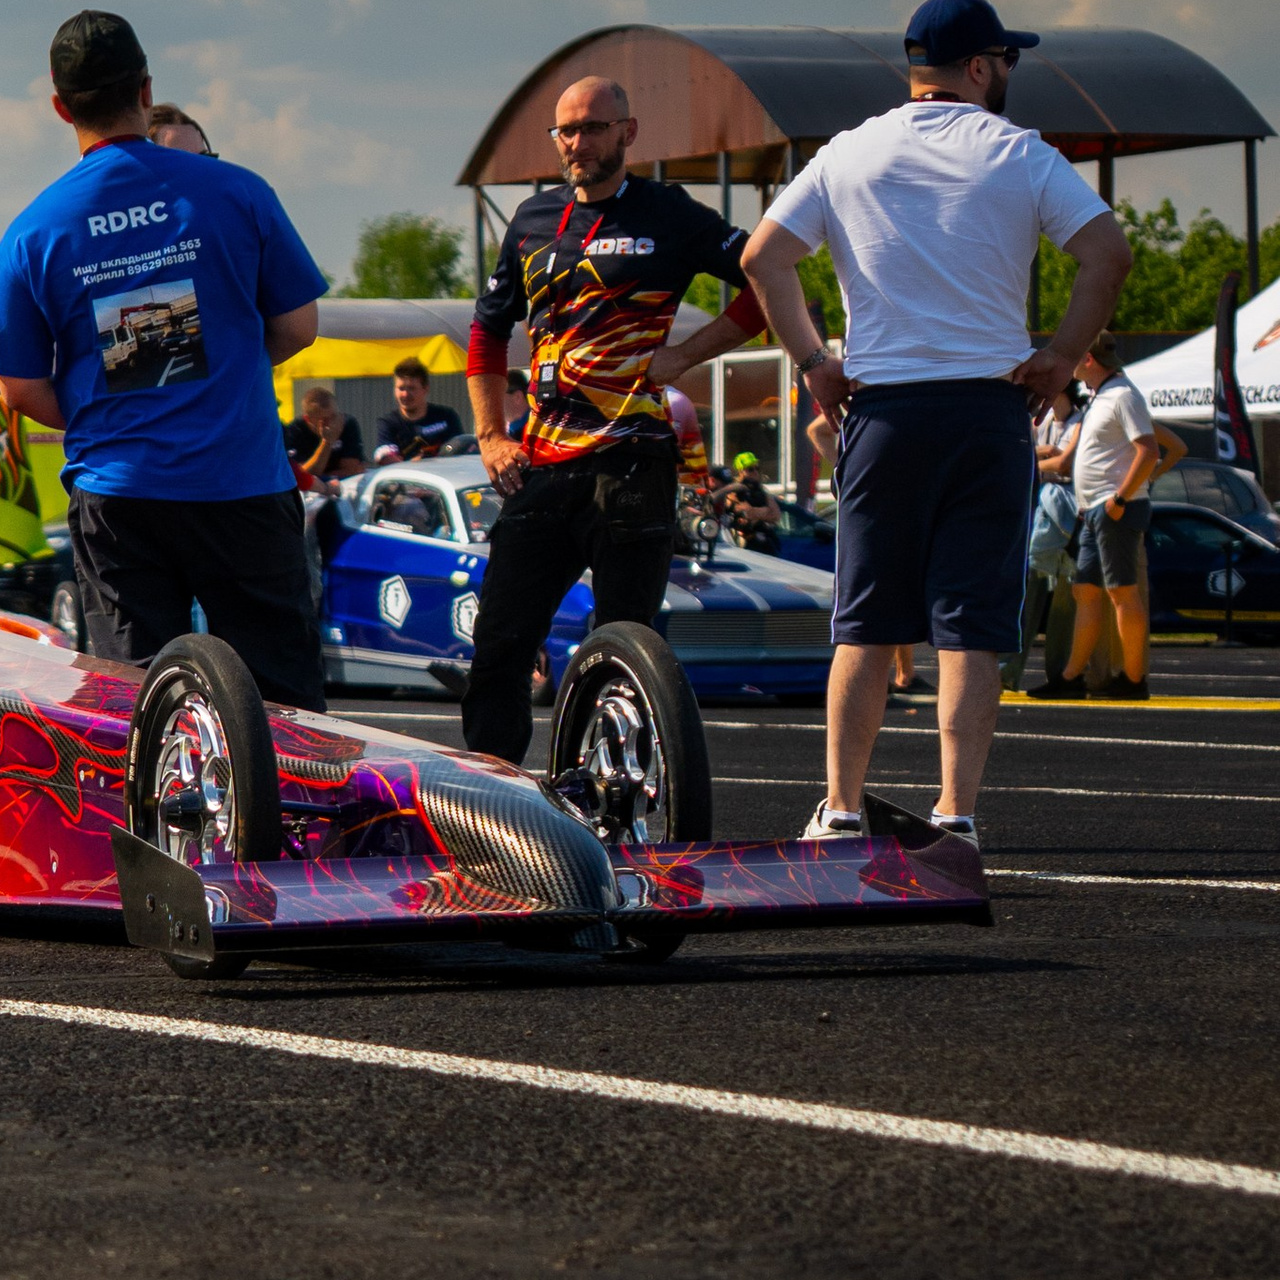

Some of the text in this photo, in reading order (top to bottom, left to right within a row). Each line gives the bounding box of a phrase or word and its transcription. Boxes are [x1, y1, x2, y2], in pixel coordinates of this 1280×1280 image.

[88, 201, 168, 237] RDRC
[73, 238, 201, 277] Ищу вкладыши на S63
[82, 251, 197, 286] Кирилл 89629181818
